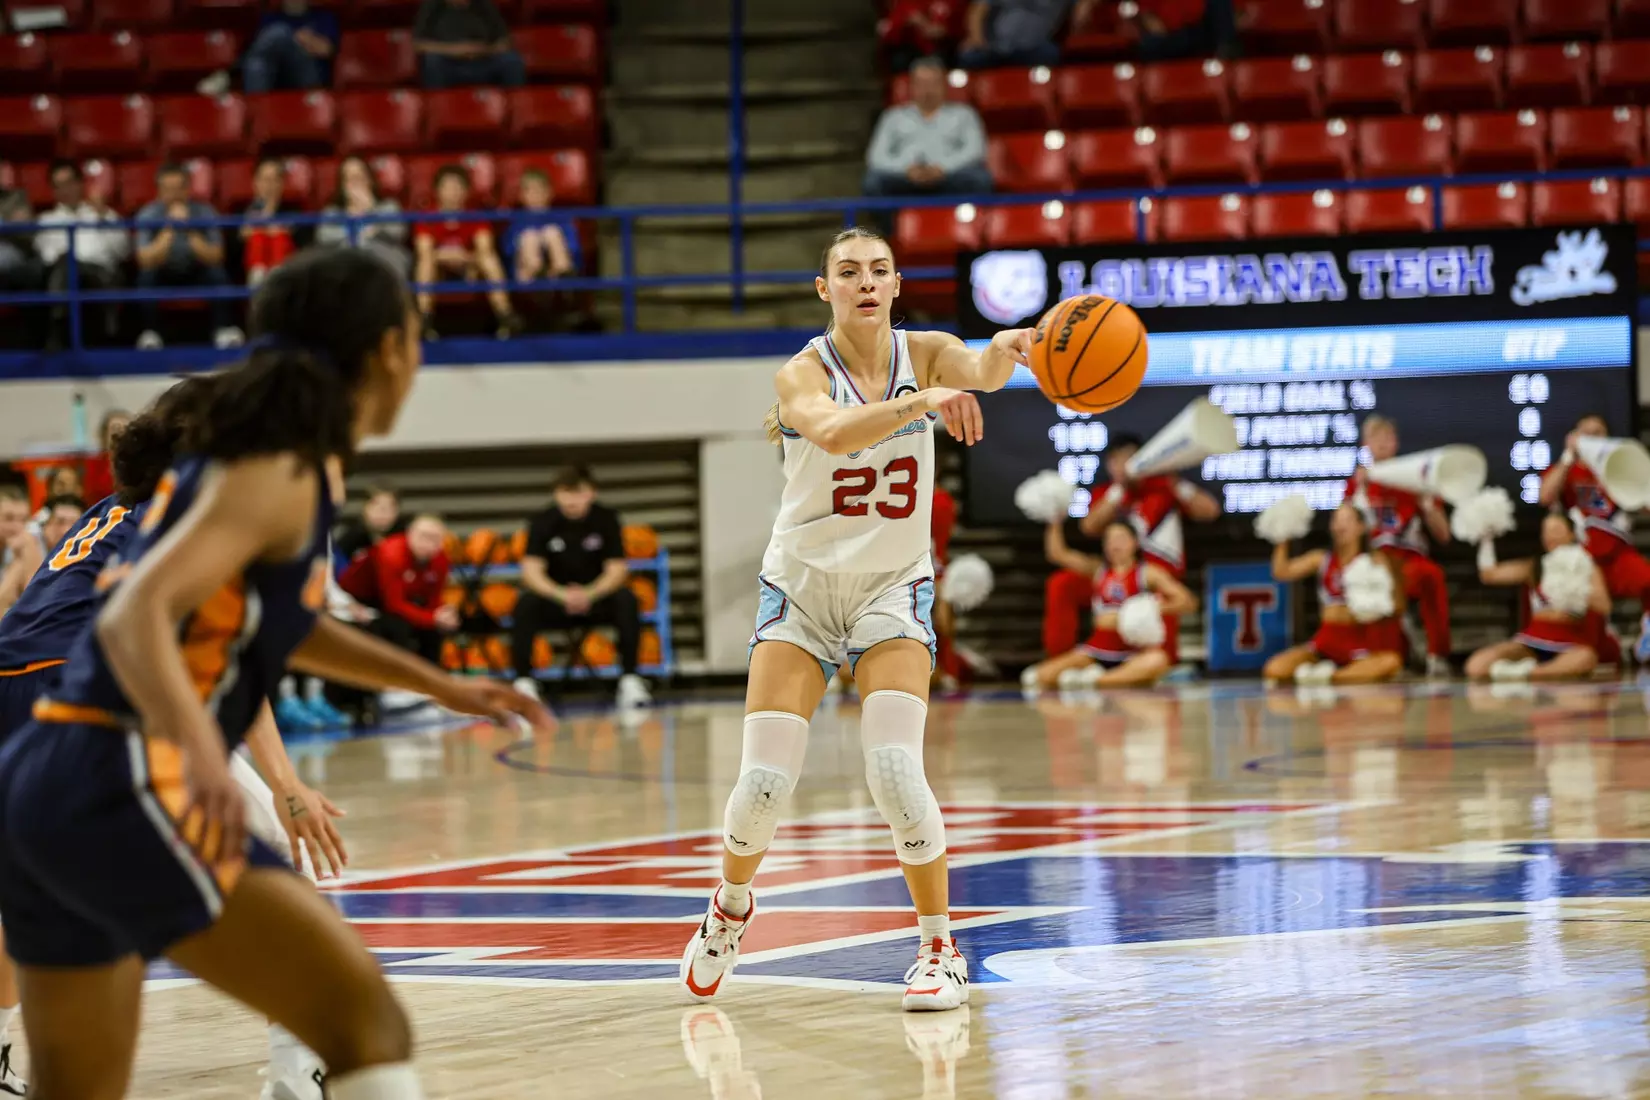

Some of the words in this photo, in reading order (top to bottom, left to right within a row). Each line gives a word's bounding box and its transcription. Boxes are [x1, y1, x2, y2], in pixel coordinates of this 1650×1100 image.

[1059, 252, 1348, 308] LOUISIANA
[1348, 245, 1494, 300] TECH
[1054, 296, 1105, 352] Wilson
[832, 455, 919, 520] 23
[1221, 585, 1277, 651] T
